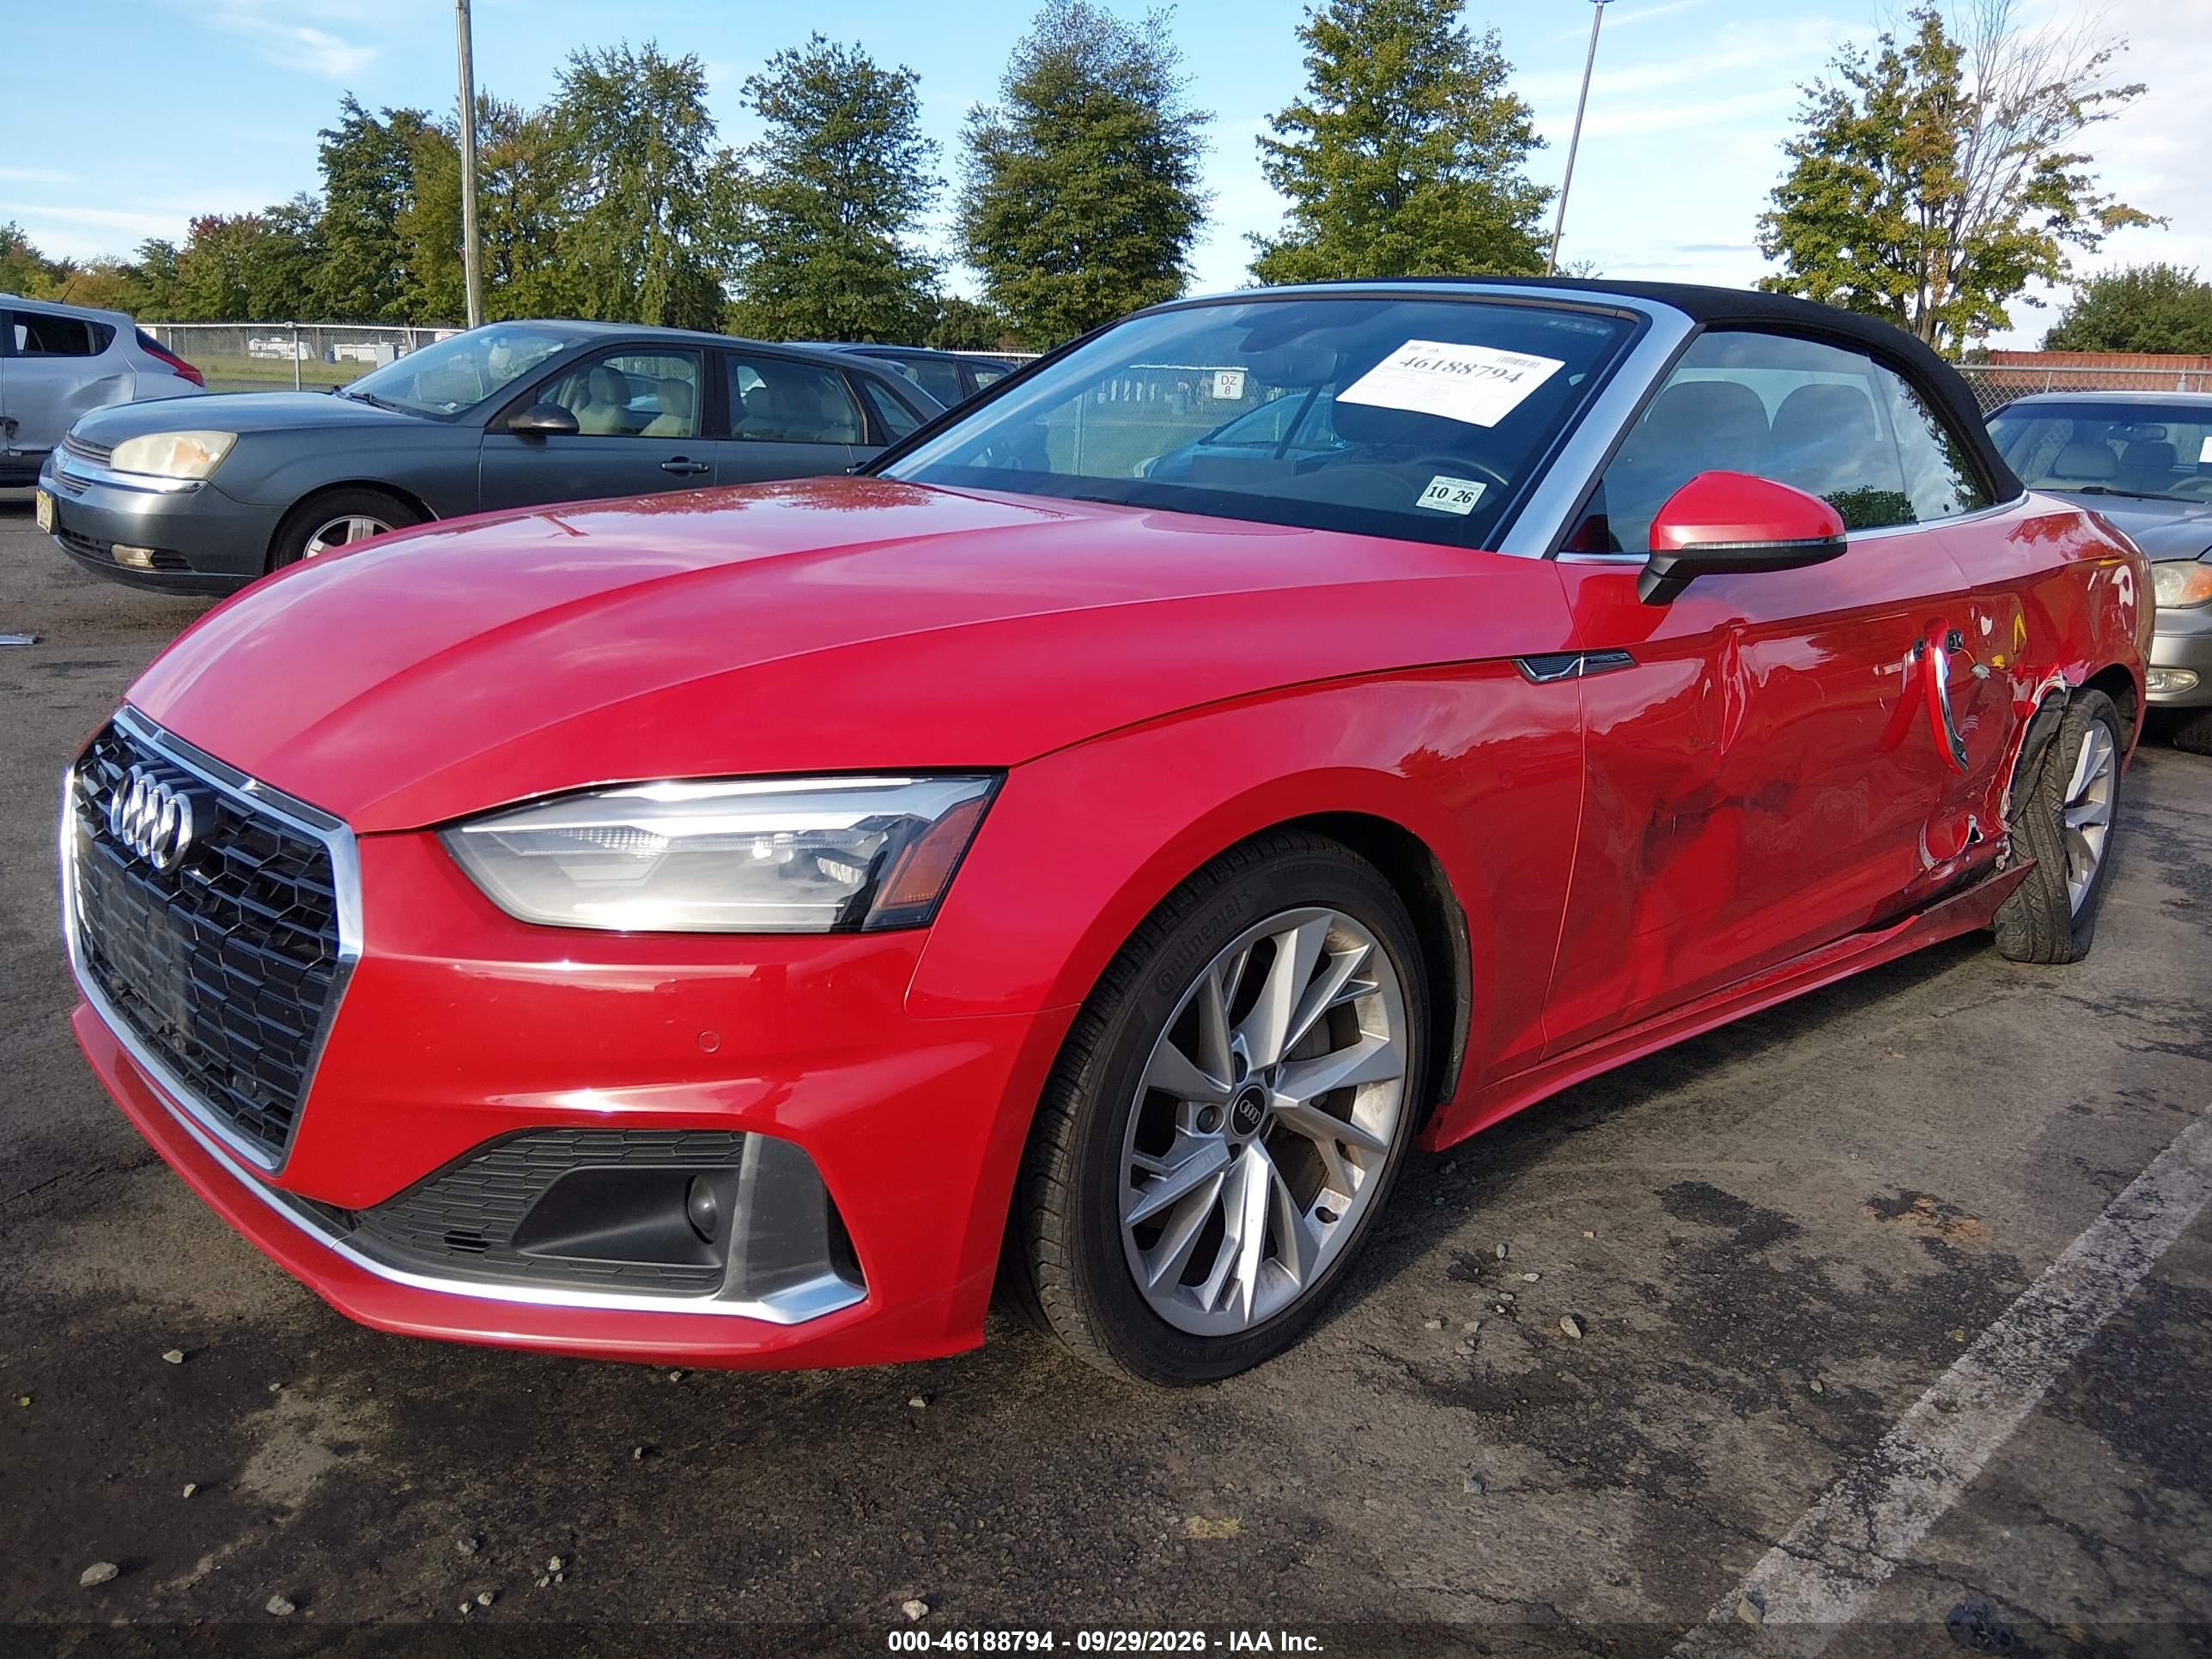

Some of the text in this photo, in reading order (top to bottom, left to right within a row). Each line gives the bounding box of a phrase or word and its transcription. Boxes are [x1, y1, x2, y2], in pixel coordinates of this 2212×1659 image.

[1400, 356, 1524, 384] 46188794
[1221, 375, 1237, 386] DZ
[1224, 386, 1231, 395] 8
[1426, 485, 1449, 500] 10
[1451, 489, 1474, 504] 26
